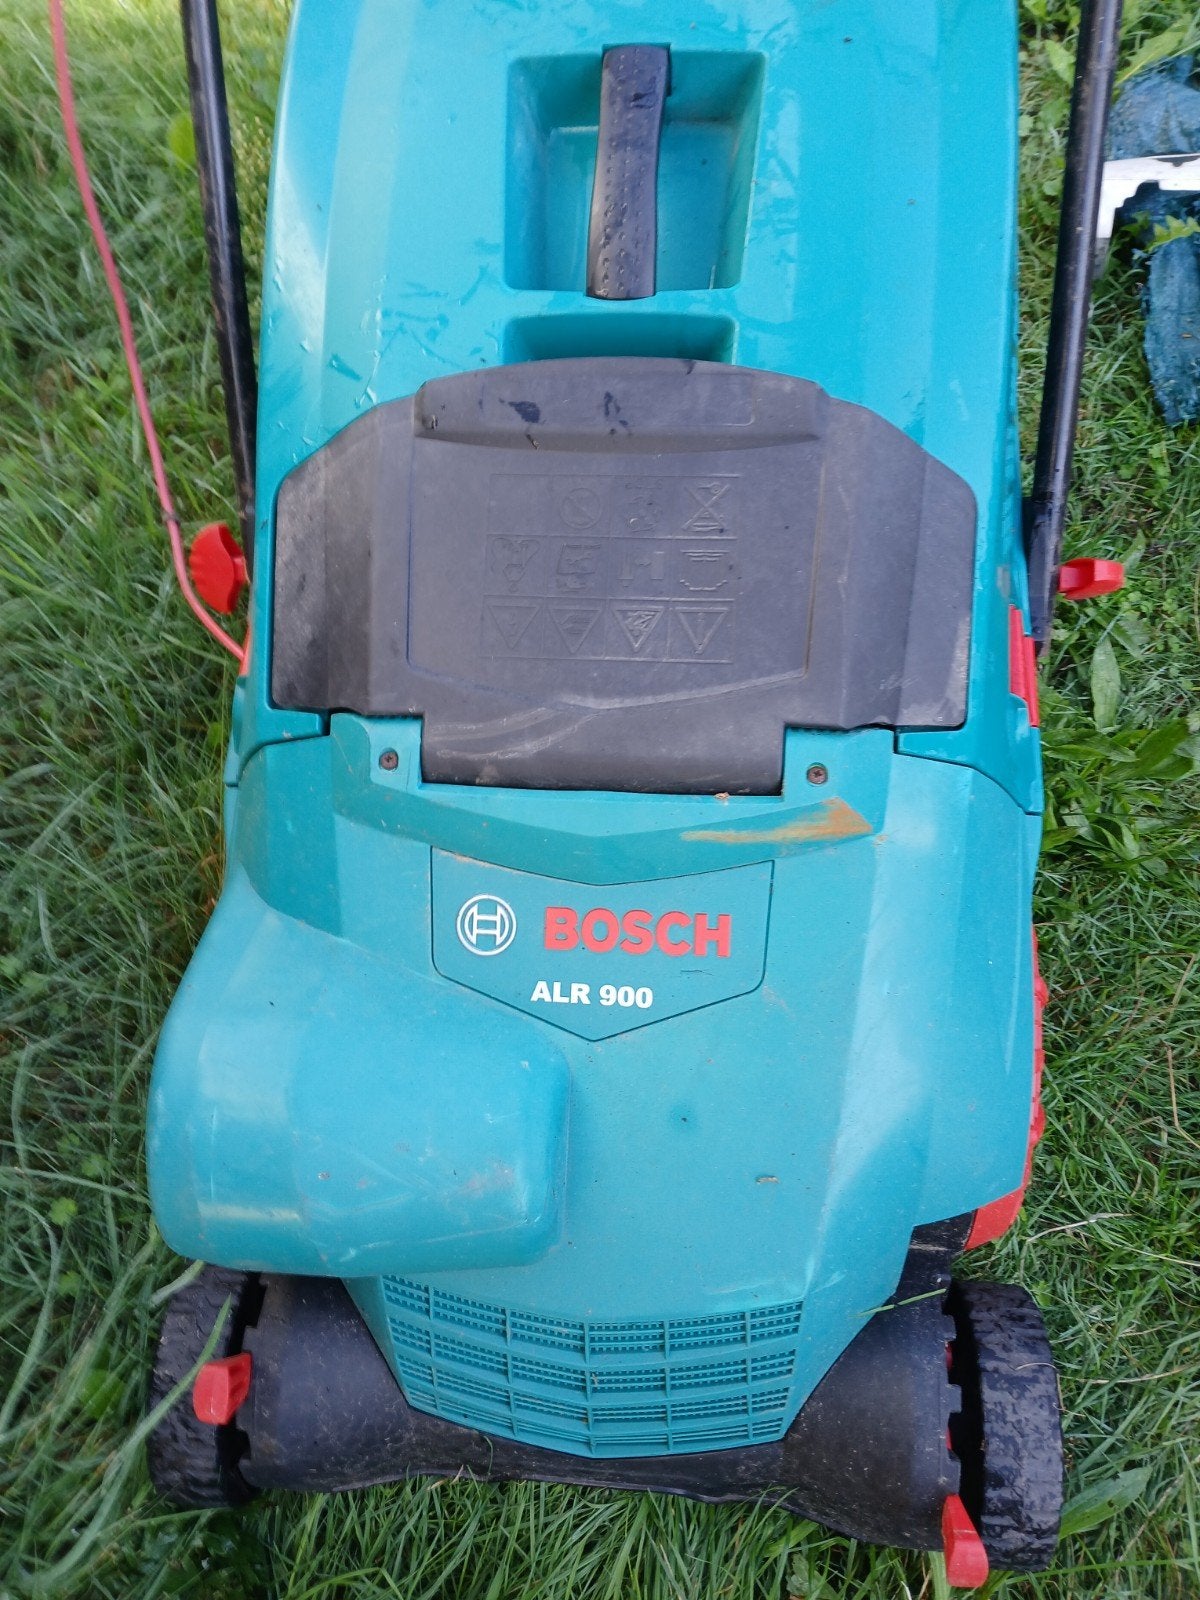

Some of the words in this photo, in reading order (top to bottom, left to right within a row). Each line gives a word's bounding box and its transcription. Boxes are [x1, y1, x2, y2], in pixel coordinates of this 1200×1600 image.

[544, 907, 731, 957] BOSCH
[530, 981, 591, 1005] ALR
[599, 985, 653, 1008] 900
